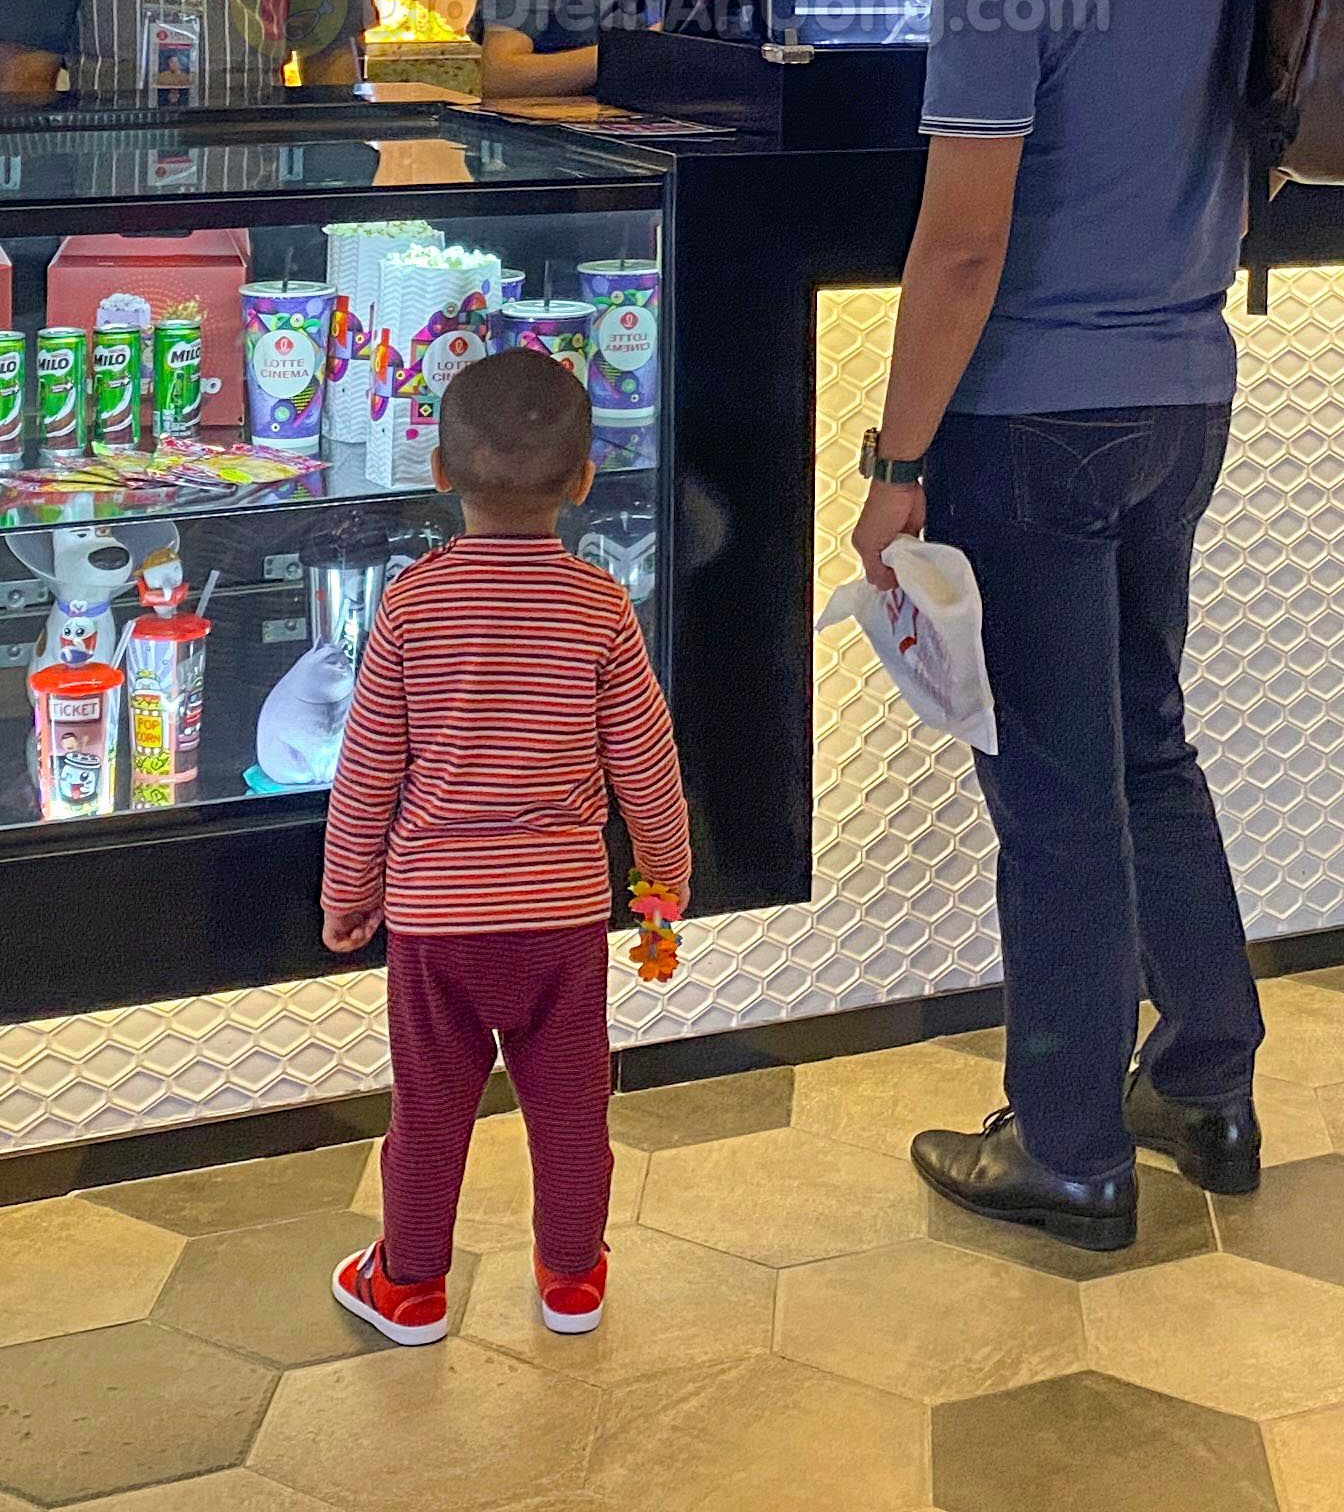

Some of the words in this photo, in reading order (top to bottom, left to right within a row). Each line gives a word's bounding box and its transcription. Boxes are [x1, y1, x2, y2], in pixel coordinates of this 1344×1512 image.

[263, 358, 305, 368] LOTTE
[437, 361, 473, 370] LOTT
[260, 368, 309, 378] CINEMA
[52, 701, 99, 718] TICKET
[137, 717, 159, 730] POP
